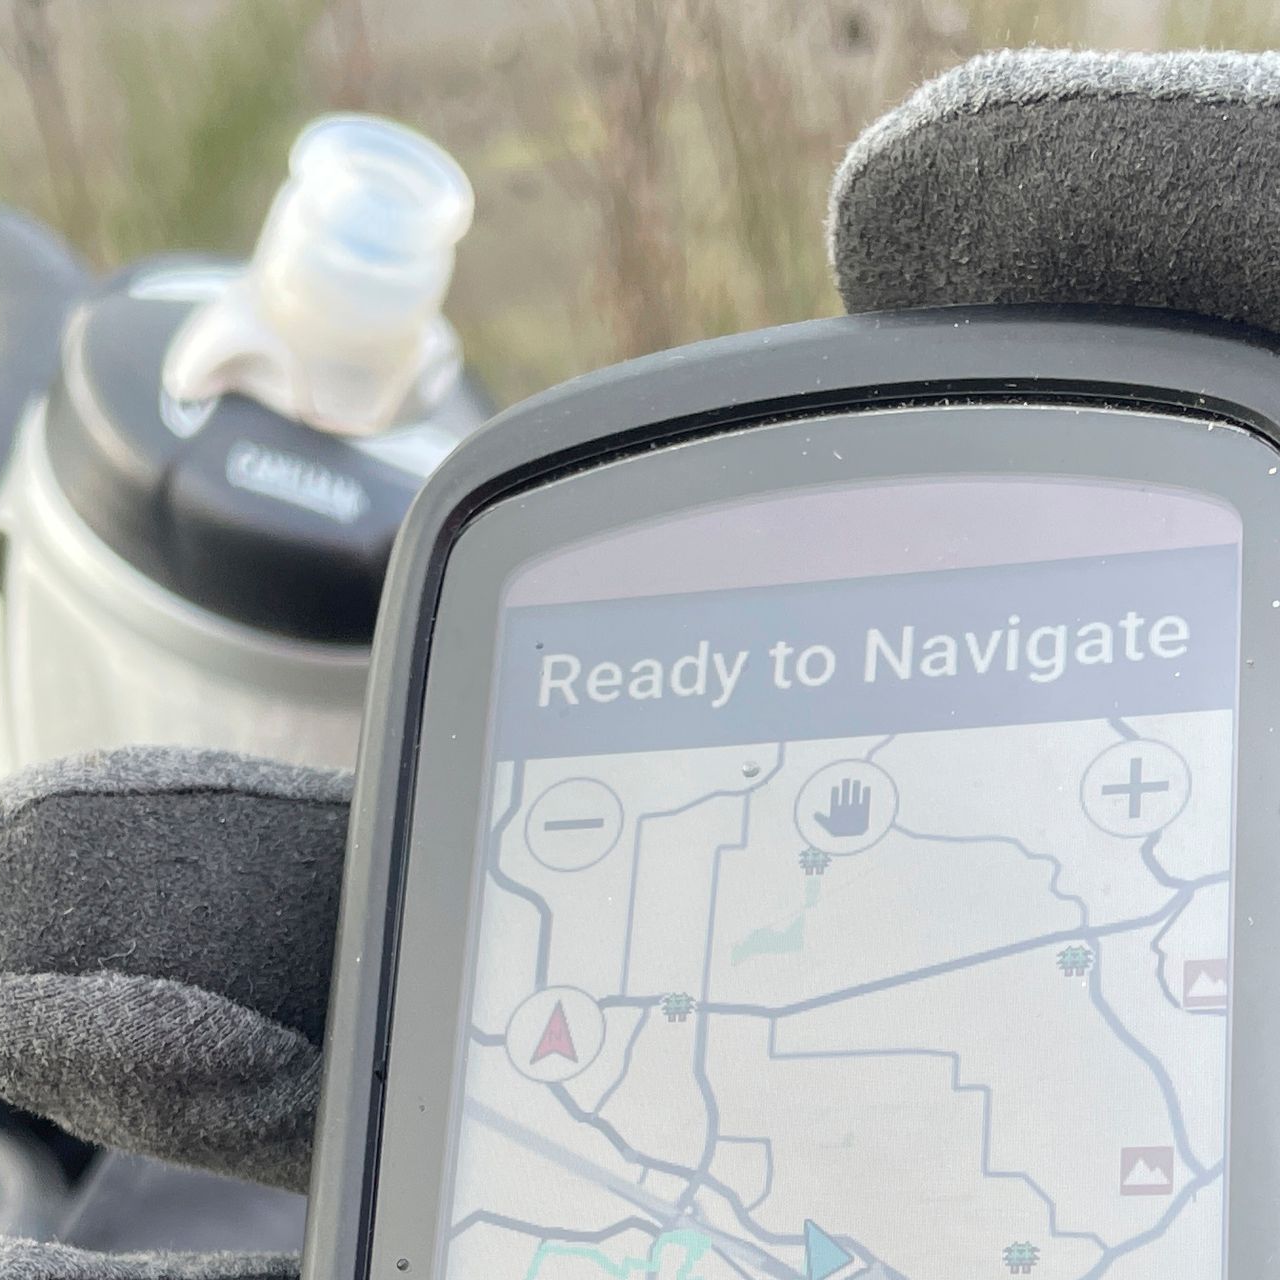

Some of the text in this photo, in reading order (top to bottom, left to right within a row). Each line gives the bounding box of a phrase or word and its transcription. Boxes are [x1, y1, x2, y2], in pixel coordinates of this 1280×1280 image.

[537, 611, 1190, 708] Ready to Navigate
